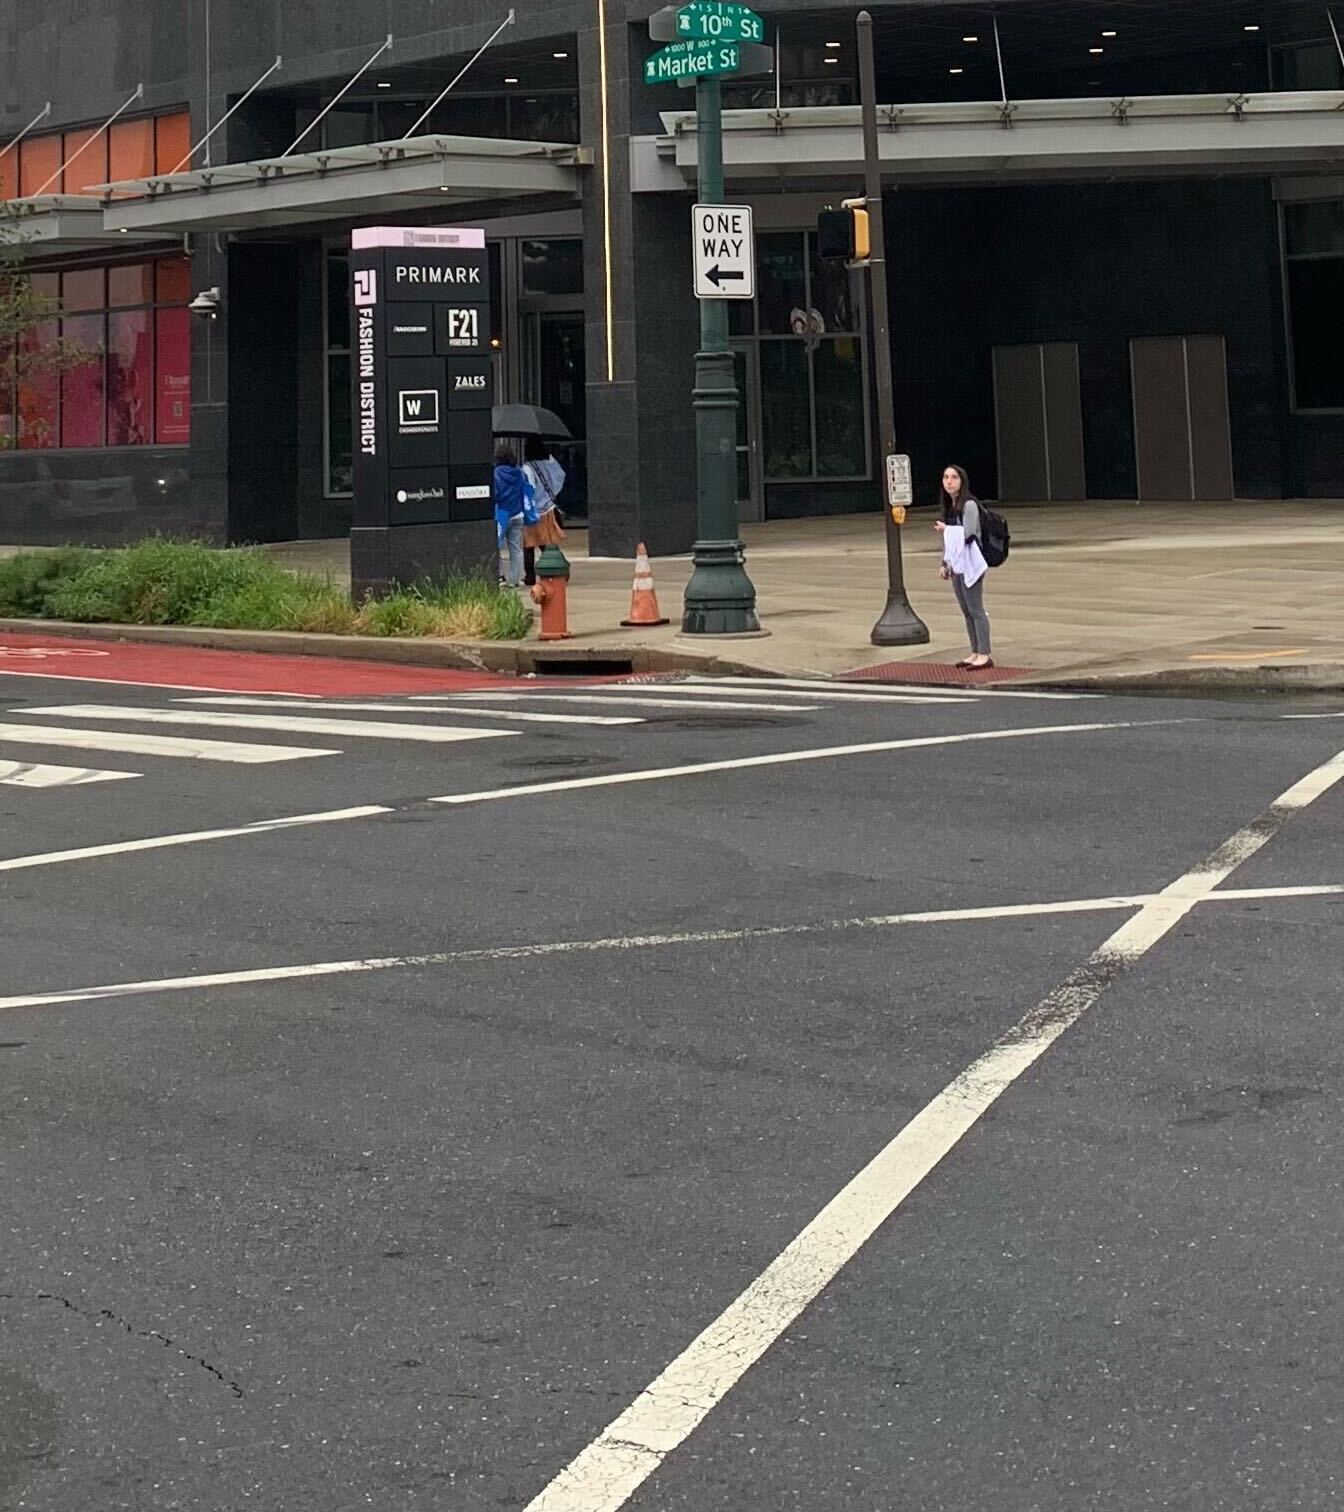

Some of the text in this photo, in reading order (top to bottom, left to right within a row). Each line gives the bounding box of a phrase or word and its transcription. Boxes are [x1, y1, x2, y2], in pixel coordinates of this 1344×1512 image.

[700, 14, 758, 38] 10th St
[658, 48, 736, 77] Market St
[703, 213, 742, 234] ONE
[702, 238, 743, 258] WAY
[396, 266, 480, 284] PRIMARK
[448, 309, 478, 338] F21
[359, 307, 374, 377] FASHION
[455, 375, 486, 388] ZALES
[360, 382, 376, 455] DISTRICT
